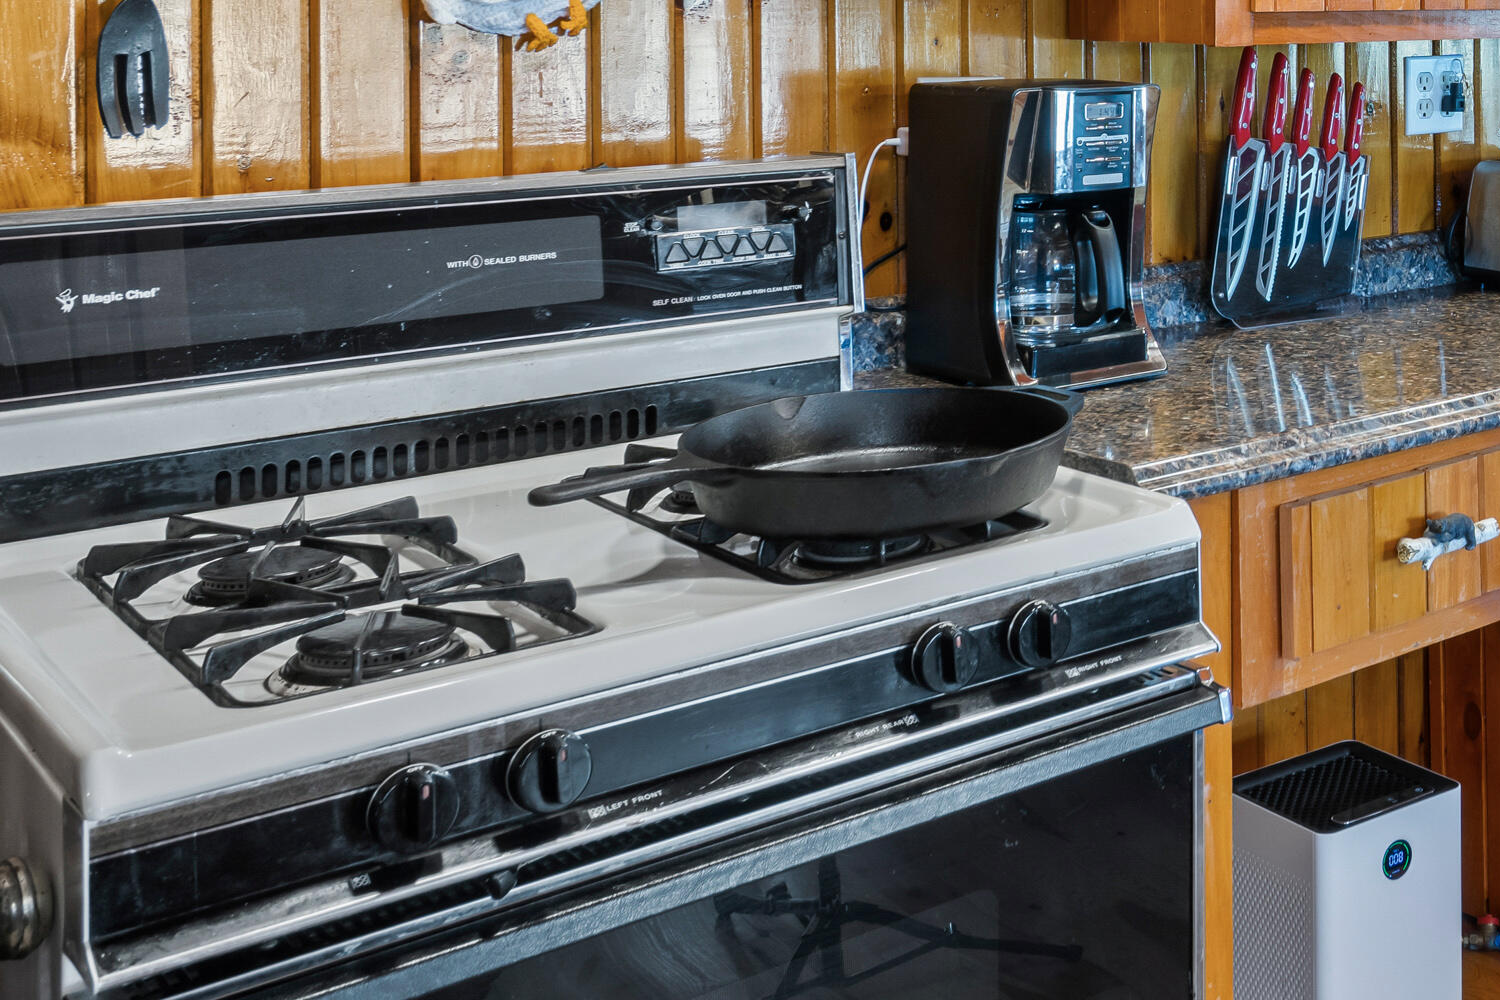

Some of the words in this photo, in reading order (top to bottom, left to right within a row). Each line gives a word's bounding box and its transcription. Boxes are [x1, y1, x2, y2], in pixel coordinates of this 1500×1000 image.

[446, 260, 469, 269] WITH
[484, 256, 517, 265] SEALED
[519, 252, 557, 262] BURNERS
[82, 291, 124, 304] Magic
[125, 287, 158, 300] Chef
[652, 299, 669, 307] SELF
[671, 297, 693, 305] CLEAN
[855, 725, 880, 738] RIGHT
[606, 799, 628, 812] LEFT
[632, 789, 662, 804] FRONT
[1388, 850, 1404, 867] 008
